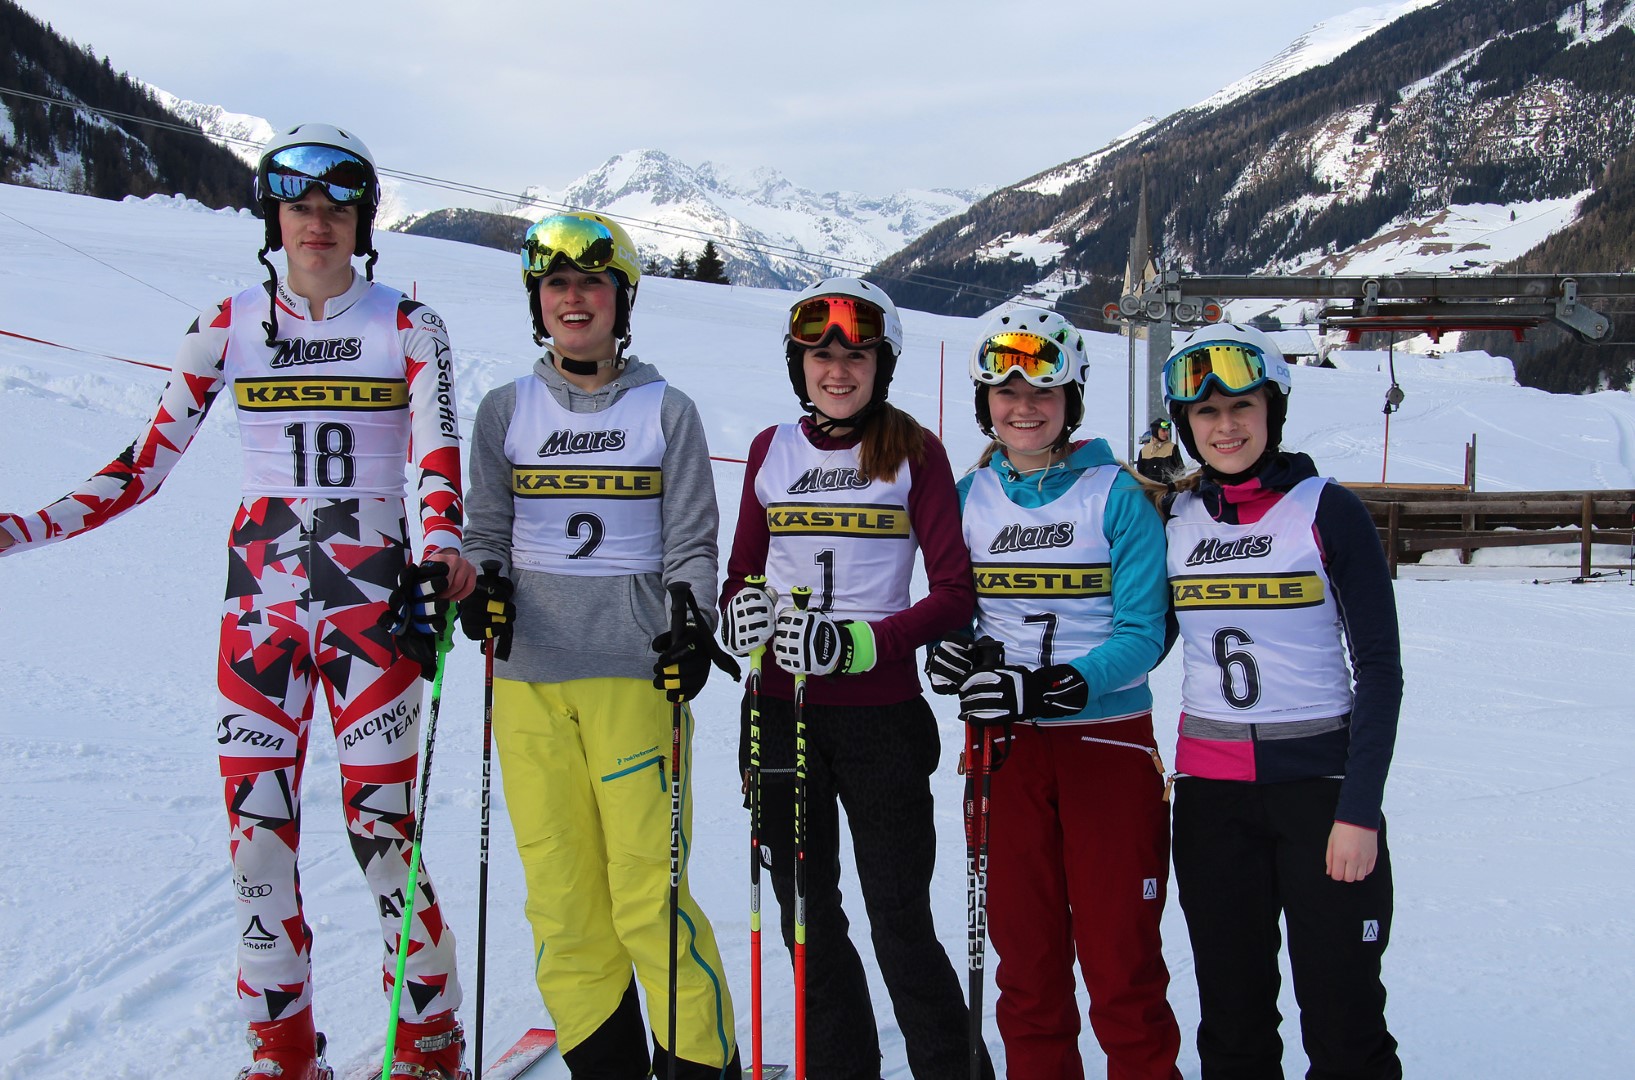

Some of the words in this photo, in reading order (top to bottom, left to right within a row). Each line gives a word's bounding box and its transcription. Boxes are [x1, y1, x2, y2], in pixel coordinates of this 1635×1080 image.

[270, 336, 362, 369] Mars
[421, 326, 439, 334] Audi
[284, 421, 357, 488] 18
[537, 428, 627, 458] Mars
[565, 511, 606, 560] 2
[987, 521, 1075, 555] Mars
[1184, 534, 1273, 567] Mars
[814, 548, 836, 614] 1
[822, 626, 830, 660] reusch
[841, 644, 853, 673] LEKI
[1021, 611, 1059, 668] 7
[1211, 626, 1262, 711] 6
[343, 700, 407, 751] RACING
[381, 702, 421, 745] TEAM
[750, 709, 760, 767] LEKI
[796, 721, 806, 779] LEKI
